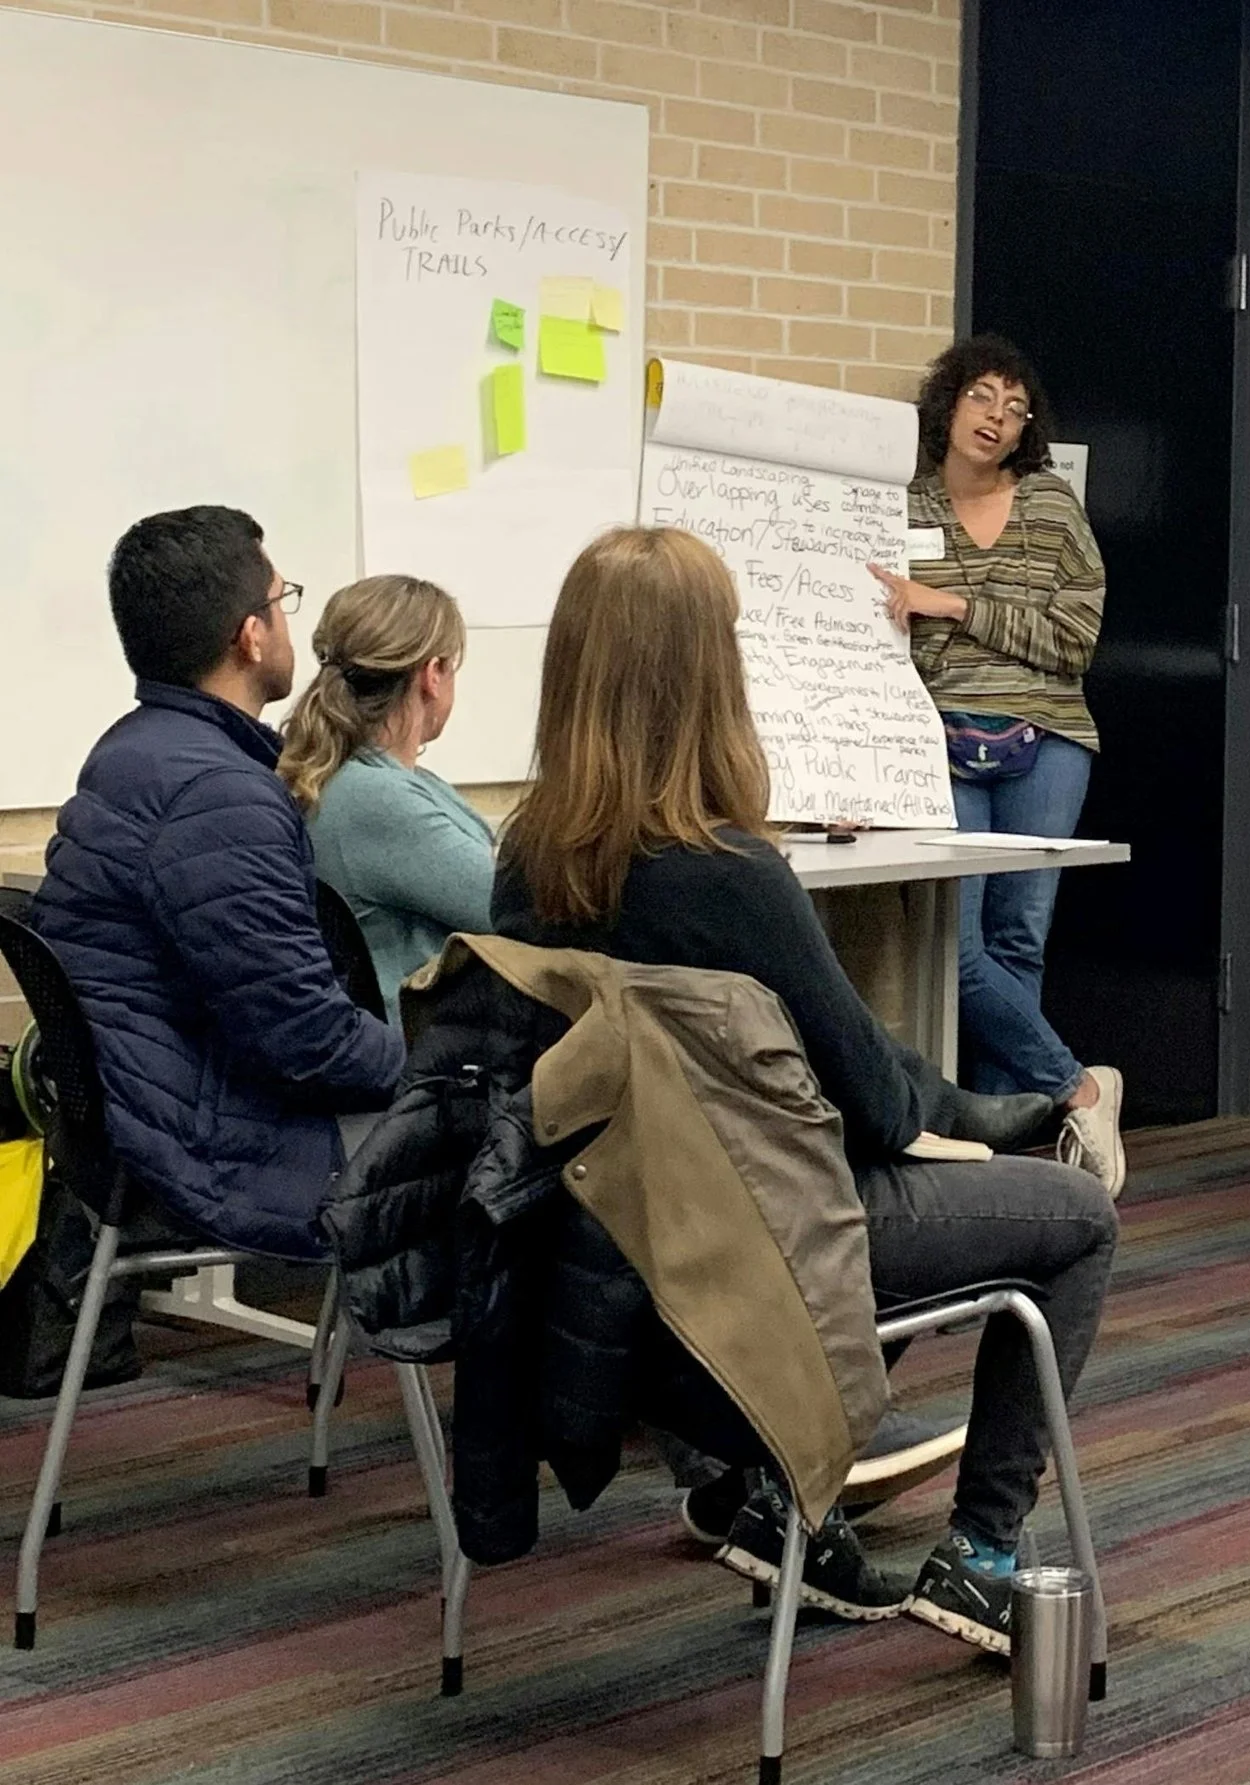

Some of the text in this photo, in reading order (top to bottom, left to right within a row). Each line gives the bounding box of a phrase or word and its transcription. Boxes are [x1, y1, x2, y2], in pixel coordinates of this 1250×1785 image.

[377, 197, 439, 243] Public
[402, 246, 488, 282] TRAILS
[1060, 461, 1074, 470] not
[658, 464, 782, 526] Overlapping
